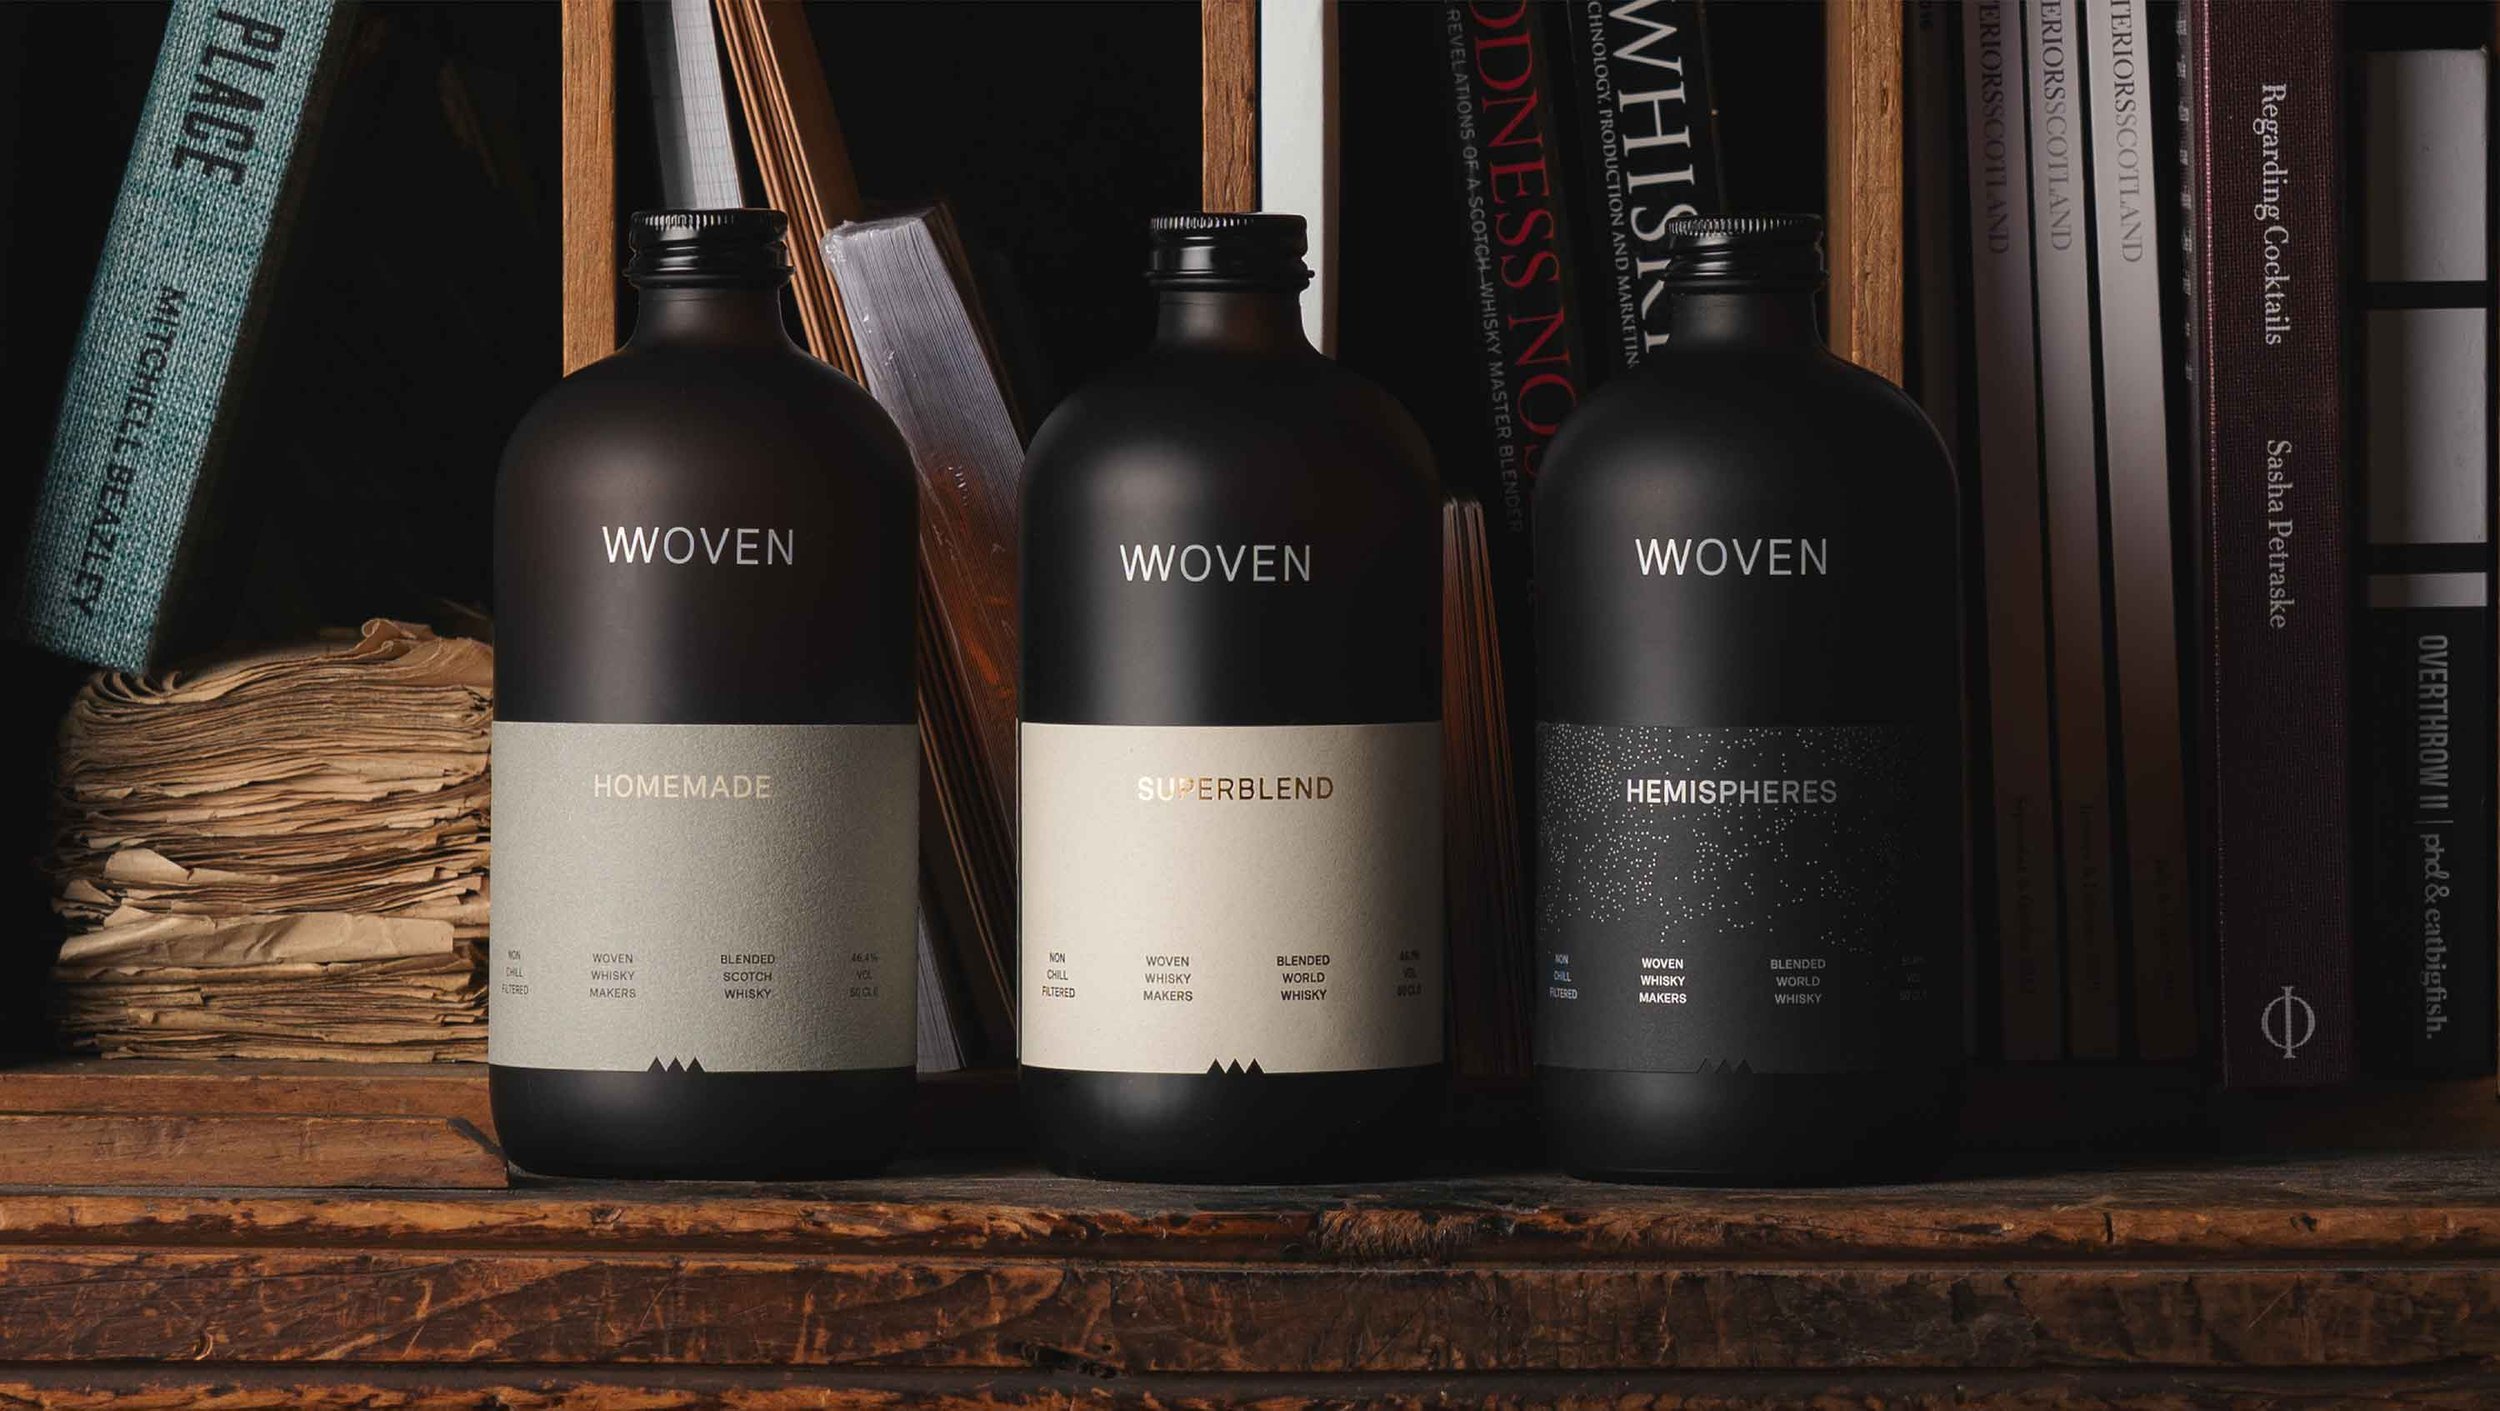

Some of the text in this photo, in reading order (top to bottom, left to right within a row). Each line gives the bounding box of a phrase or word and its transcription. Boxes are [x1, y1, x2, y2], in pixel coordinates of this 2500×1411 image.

[1446, 9, 1476, 140] REVELATIONS
[172, 10, 286, 186] PLACE
[1979, 0, 2009, 254] ERIORSSCOTLAND
[1461, 146, 1478, 172] OF
[1600, 108, 1626, 227] PRODUCTION
[2253, 84, 2291, 346] Regarding Cocktails
[1467, 195, 1492, 272] SCOTCH
[1612, 231, 1630, 270] AND
[1478, 282, 1502, 355] WHISKY
[1617, 275, 1640, 369] MARKETIN
[1488, 361, 1513, 440] MASTER
[71, 284, 187, 618] MITCHELL BEAZLEY
[1498, 444, 1523, 533] BLENDER
[2267, 438, 2295, 629] Sasha Petraske
[603, 527, 792, 564] WOVEN
[1120, 545, 1309, 581] WOVEN
[1636, 539, 1826, 575] WOVEN
[2418, 635, 2449, 787] OVERTHROW
[594, 774, 772, 799] HOMEMADE
[1137, 777, 1334, 801] SUPERBLEND
[1626, 780, 1837, 804] HEMISPHERES
[2420, 794, 2449, 809] II
[593, 954, 633, 963] WOVEN
[721, 954, 775, 964] BLENDED
[1049, 953, 1065, 963] NON
[1146, 956, 1189, 966] WOVEN
[1277, 955, 1330, 966] BLENDED
[1555, 955, 1568, 964] NON
[1642, 958, 1683, 969] WOVEN
[1771, 959, 1825, 969] BLENDED
[591, 971, 634, 980] WHISKY
[723, 972, 772, 981] SCOTCH
[1047, 969, 1068, 980] CHILL
[1145, 974, 1191, 984] WHISKY
[1283, 972, 1325, 983] WORLD
[1553, 971, 1571, 982] CHILL
[1641, 976, 1685, 986] WHISKY
[1776, 977, 1820, 986] WORLD
[590, 988, 636, 998] MAKERS
[725, 989, 771, 999] WHISKY
[1042, 986, 1075, 998] FILTERED
[1144, 991, 1192, 1001] MAKERS
[1281, 990, 1326, 1000] WHISKY
[1549, 987, 1577, 999] FILTERED
[1640, 993, 1686, 1003] MAKERS
[1775, 994, 1821, 1004] WHISKY
